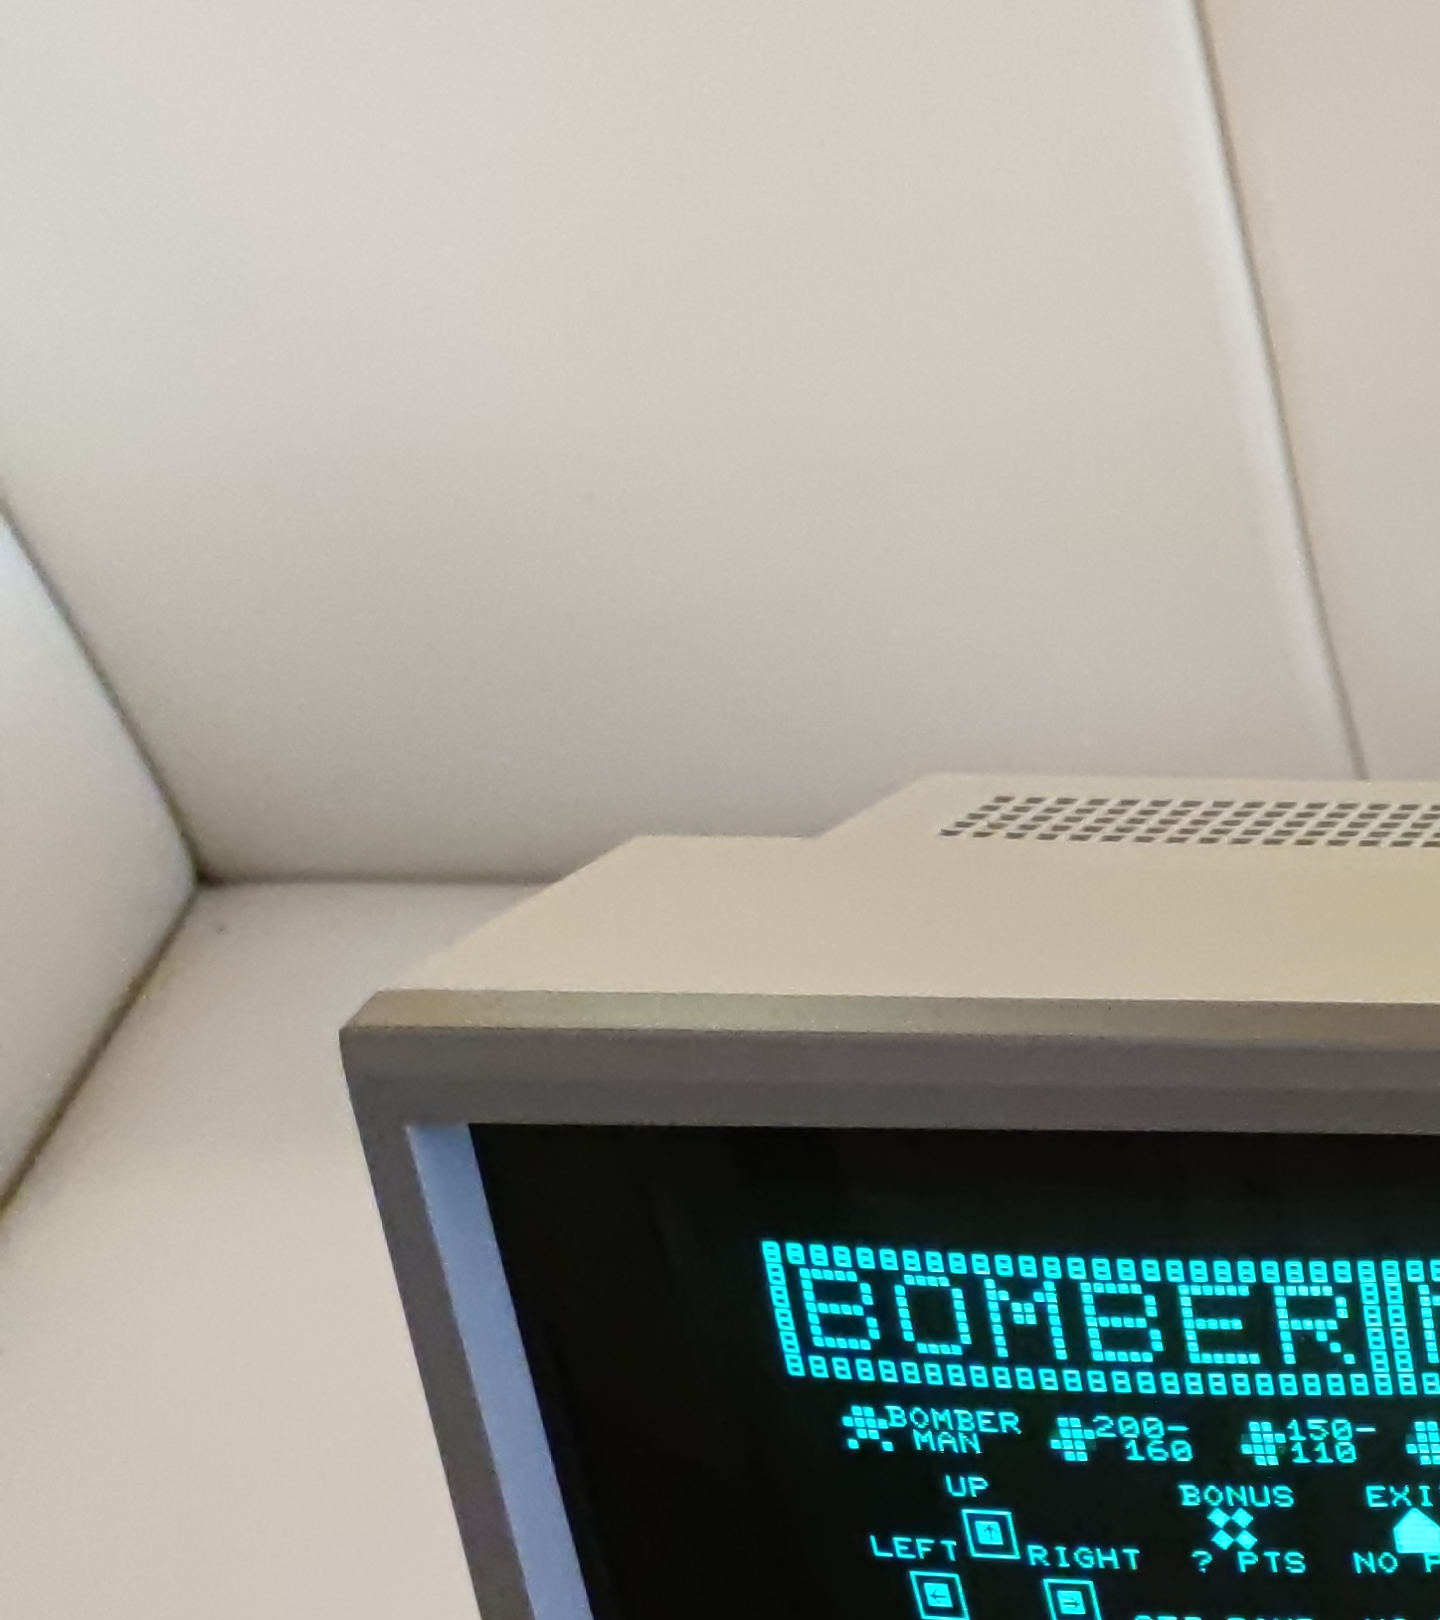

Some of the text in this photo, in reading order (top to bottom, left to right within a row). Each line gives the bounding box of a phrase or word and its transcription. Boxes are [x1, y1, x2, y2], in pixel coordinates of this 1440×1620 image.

[800, 1268, 1354, 1363] BOMBER
[885, 1406, 1022, 1435] BOMBER
[913, 1429, 983, 1454] MAN
[1125, 1440, 1193, 1462] 160
[1292, 1442, 1357, 1464] 110
[945, 1475, 989, 1498] UP
[1178, 1484, 1295, 1508] BONUS
[869, 1535, 958, 1561] LEFT
[1026, 1544, 1141, 1571] RIGHT
[1191, 1550, 1306, 1574] ? PTS
[1353, 1551, 1399, 1574] NO
